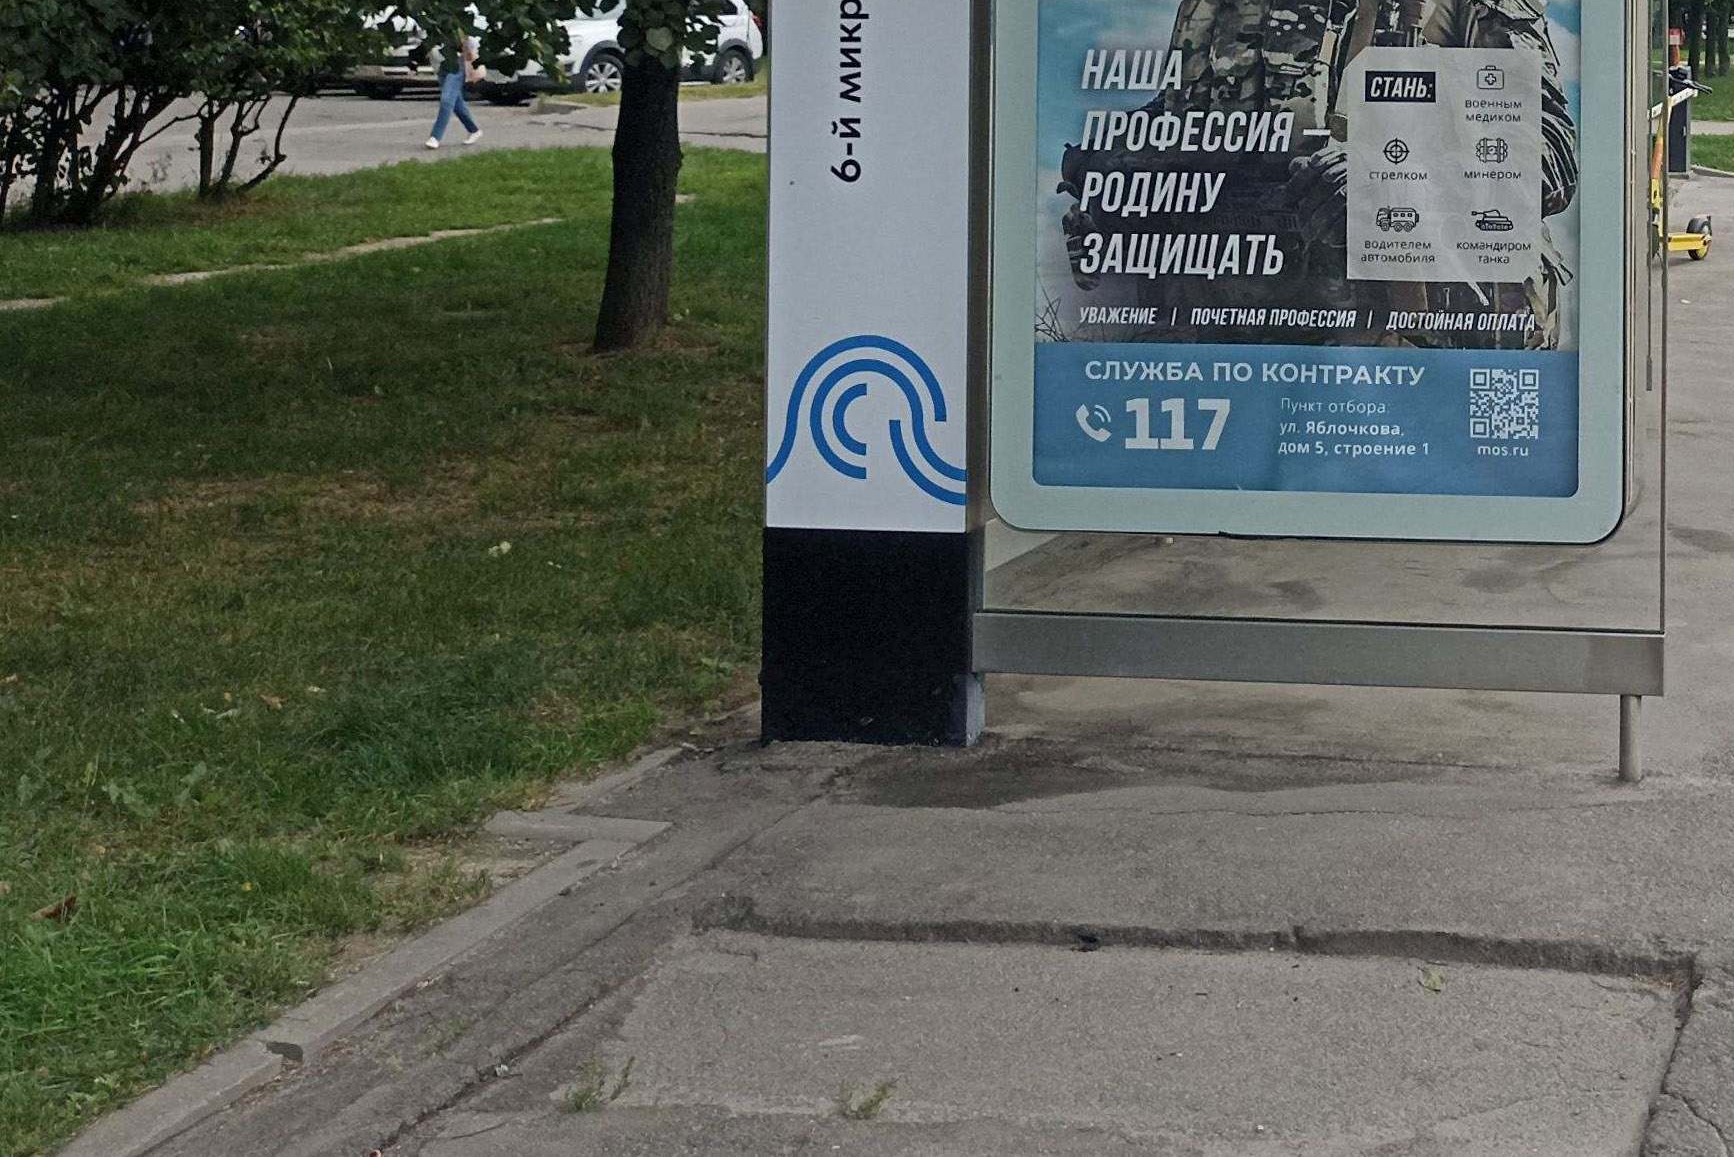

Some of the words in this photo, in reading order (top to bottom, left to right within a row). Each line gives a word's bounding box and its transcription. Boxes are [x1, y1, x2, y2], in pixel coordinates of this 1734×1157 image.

[1081, 49, 1183, 90] НАША
[1370, 76, 1433, 99] СТАНЬ:
[1465, 99, 1522, 109] военным
[1465, 113, 1521, 123] медиком
[1080, 110, 1295, 153] ПРОФЕССИЯ
[831, 117, 862, 183] 6-й
[1369, 171, 1428, 181] стрелком
[1464, 171, 1522, 181] минером
[1079, 171, 1226, 217] РОДИНУ
[1365, 241, 1431, 251] водителем
[1456, 242, 1531, 253] командиром
[1080, 233, 1285, 280] ЗАЩИЩАТЬ
[1361, 253, 1435, 263] автомобиля
[1478, 255, 1510, 264] танка
[1079, 306, 1157, 325] УВАЖЕНИЕ
[1191, 308, 1265, 326] ПОЧЕТНАЯ
[1269, 309, 1357, 328] ПРОФЕССИЯ
[1386, 310, 1474, 331] ДОСТОЙНАЯ
[1477, 313, 1535, 332] ОПЛАТА
[1085, 360, 1204, 382] СЛУЖБА
[1213, 362, 1253, 382] ПО
[1262, 363, 1425, 385] КОНТРАКТУ
[1281, 398, 1322, 414] Пункт
[1125, 397, 1231, 450] 117
[1279, 422, 1300, 435] ул.
[1278, 441, 1310, 454] дом
[1315, 441, 1328, 456] 5,
[1334, 443, 1416, 458] строение
[1422, 442, 1429, 455] 1
[1477, 445, 1529, 456] mos.ru
